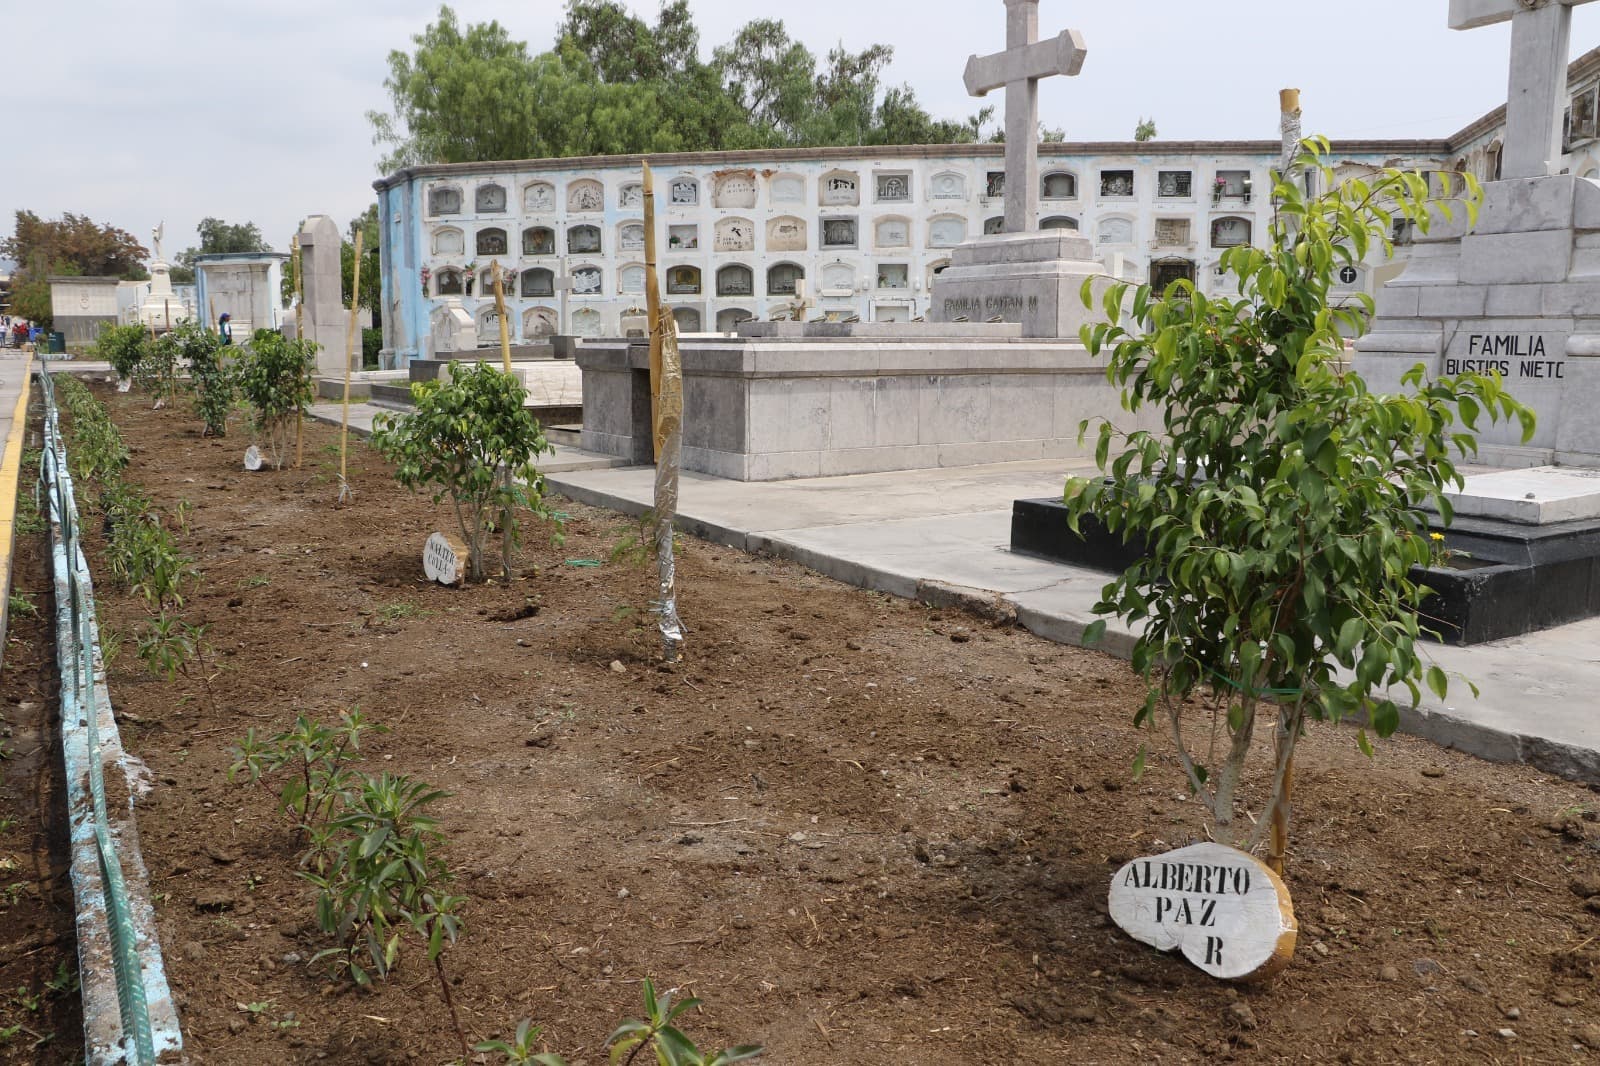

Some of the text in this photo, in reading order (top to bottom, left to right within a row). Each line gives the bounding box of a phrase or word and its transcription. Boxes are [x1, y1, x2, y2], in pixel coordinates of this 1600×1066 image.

[944, 297, 981, 311] FAMILIA
[1468, 334, 1546, 357] FAMILIA
[1446, 358, 1510, 377] BUSTIOS
[1124, 861, 1251, 896] ALBERTO
[1154, 896, 1217, 927] PAZ
[1204, 936, 1224, 966] R
